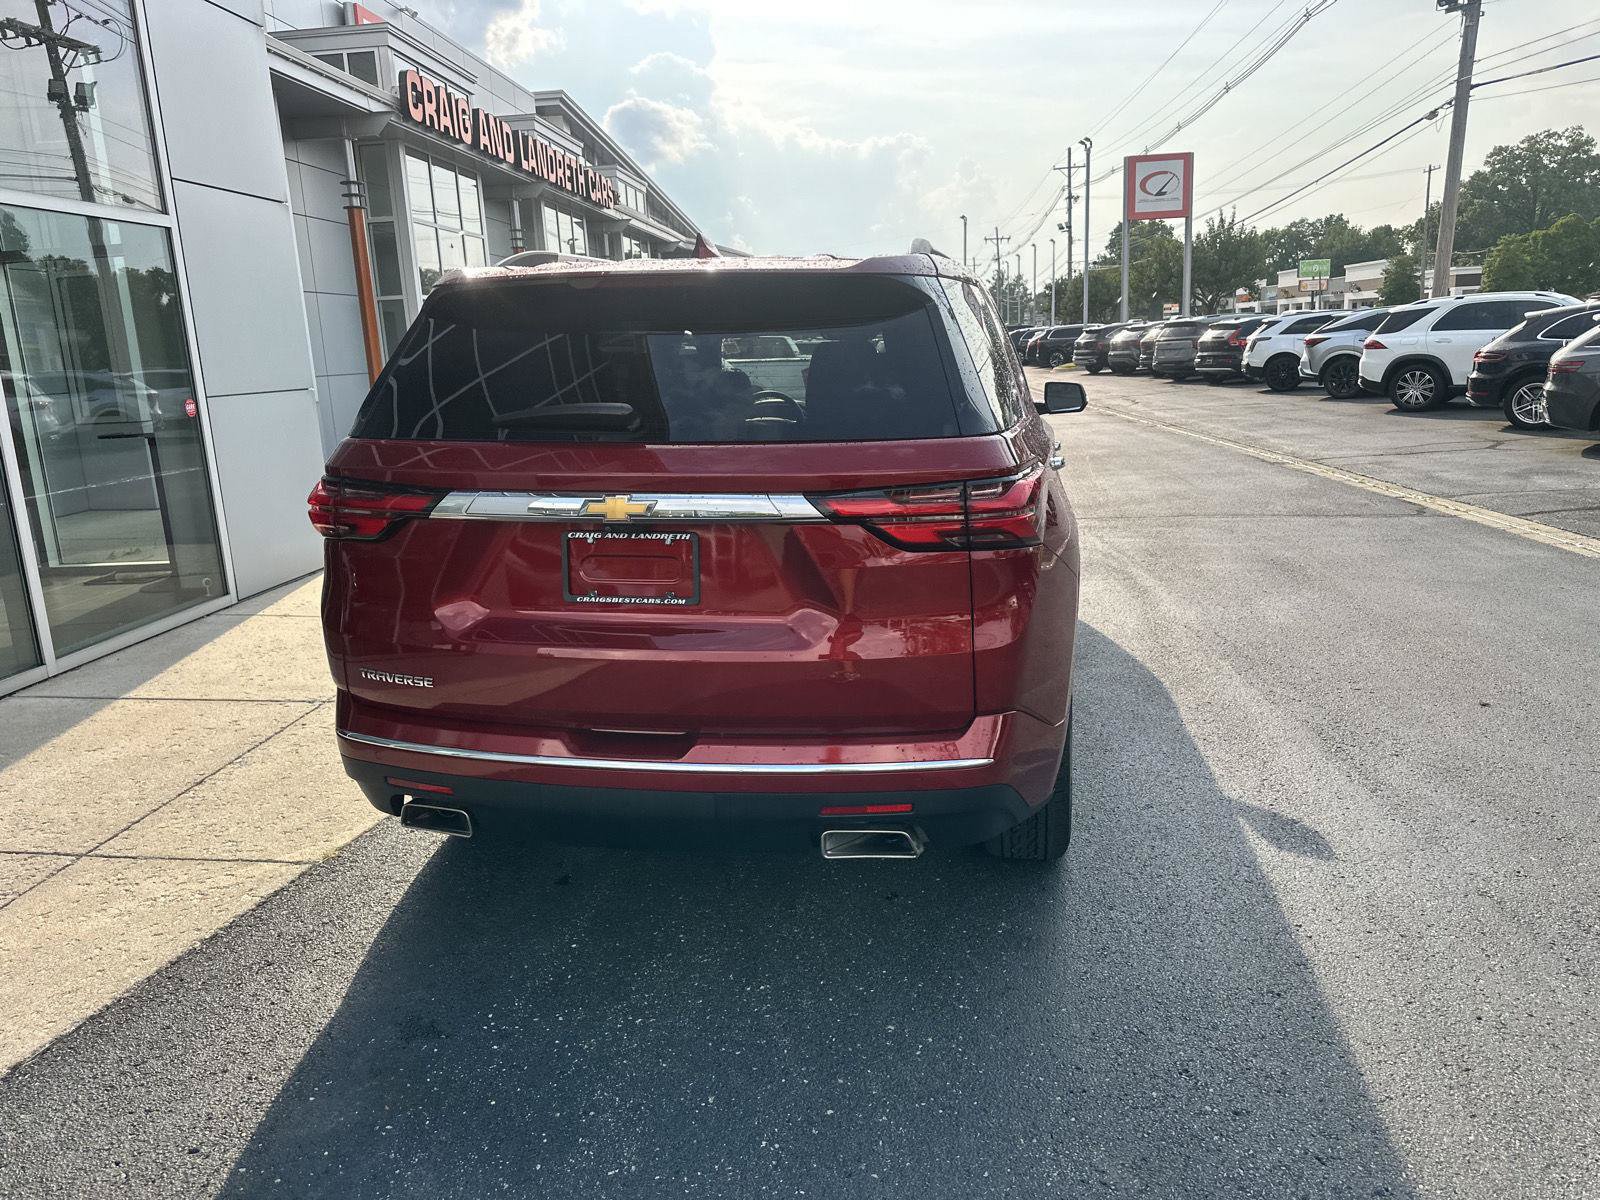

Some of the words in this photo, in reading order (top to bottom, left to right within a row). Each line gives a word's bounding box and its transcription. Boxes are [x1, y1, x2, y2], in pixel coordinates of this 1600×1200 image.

[399, 69, 473, 145] CRAIG
[474, 108, 515, 164] AND
[517, 130, 587, 198] LANDRETH
[586, 168, 615, 209] CARS
[567, 532, 602, 540] CRAIG
[604, 532, 628, 540] AND
[630, 532, 691, 541] LANDRETH
[576, 596, 686, 605] CRAIGSBESTCARS.COM
[359, 667, 434, 688] TRAVERSE
